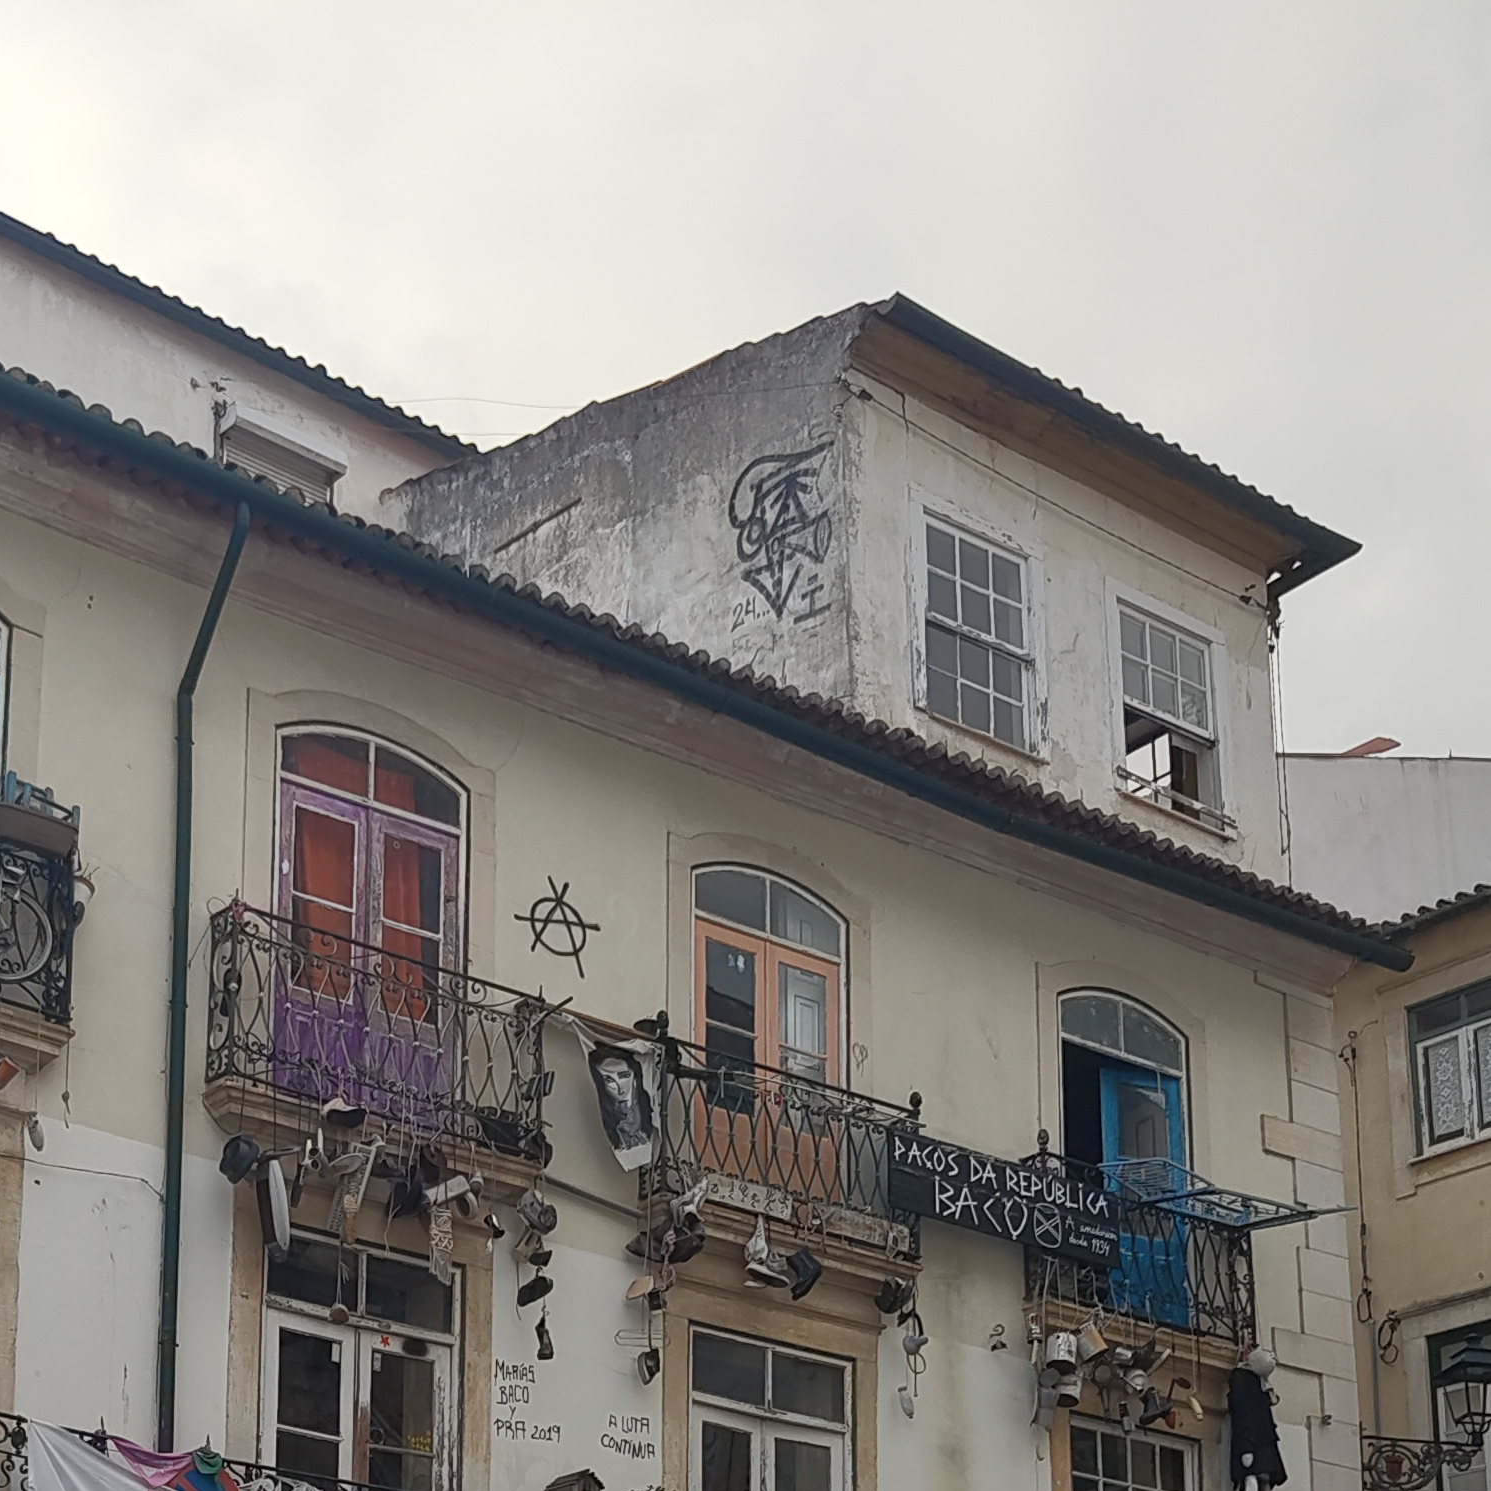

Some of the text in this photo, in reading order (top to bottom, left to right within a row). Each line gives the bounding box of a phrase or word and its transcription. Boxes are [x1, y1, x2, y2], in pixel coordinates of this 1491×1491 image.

[893, 1136, 1110, 1219] PAÇOS DA REPÚBLICA
[1091, 1238, 1111, 1257] 1934
[496, 1384, 530, 1405] BACO
[494, 1418, 561, 1443] PRA 2019
[608, 1413, 650, 1435] A LUTA
